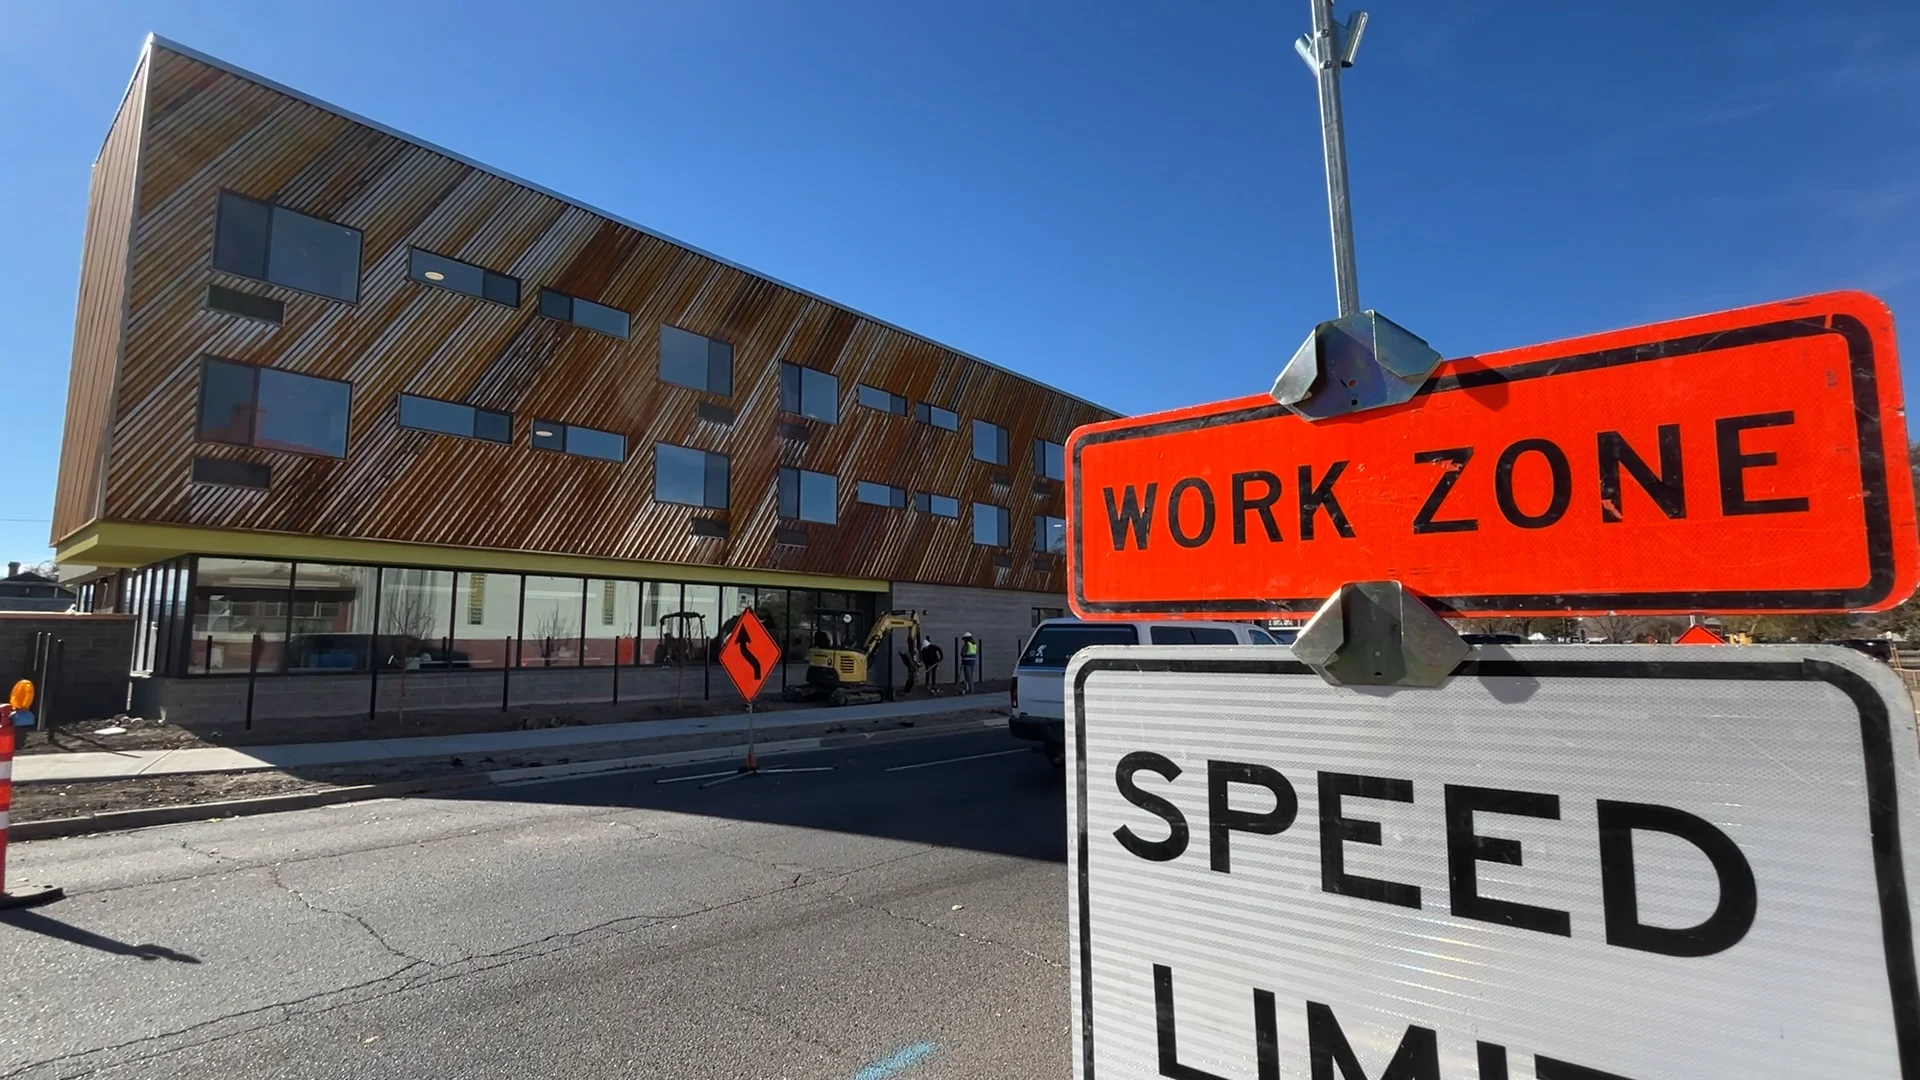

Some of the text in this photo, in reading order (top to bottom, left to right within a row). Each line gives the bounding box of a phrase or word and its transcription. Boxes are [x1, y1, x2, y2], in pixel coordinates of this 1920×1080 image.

[1104, 410, 1810, 551] WORK ZONE
[1112, 750, 1758, 958] SPEED
[1152, 963, 1643, 1080] LIM
